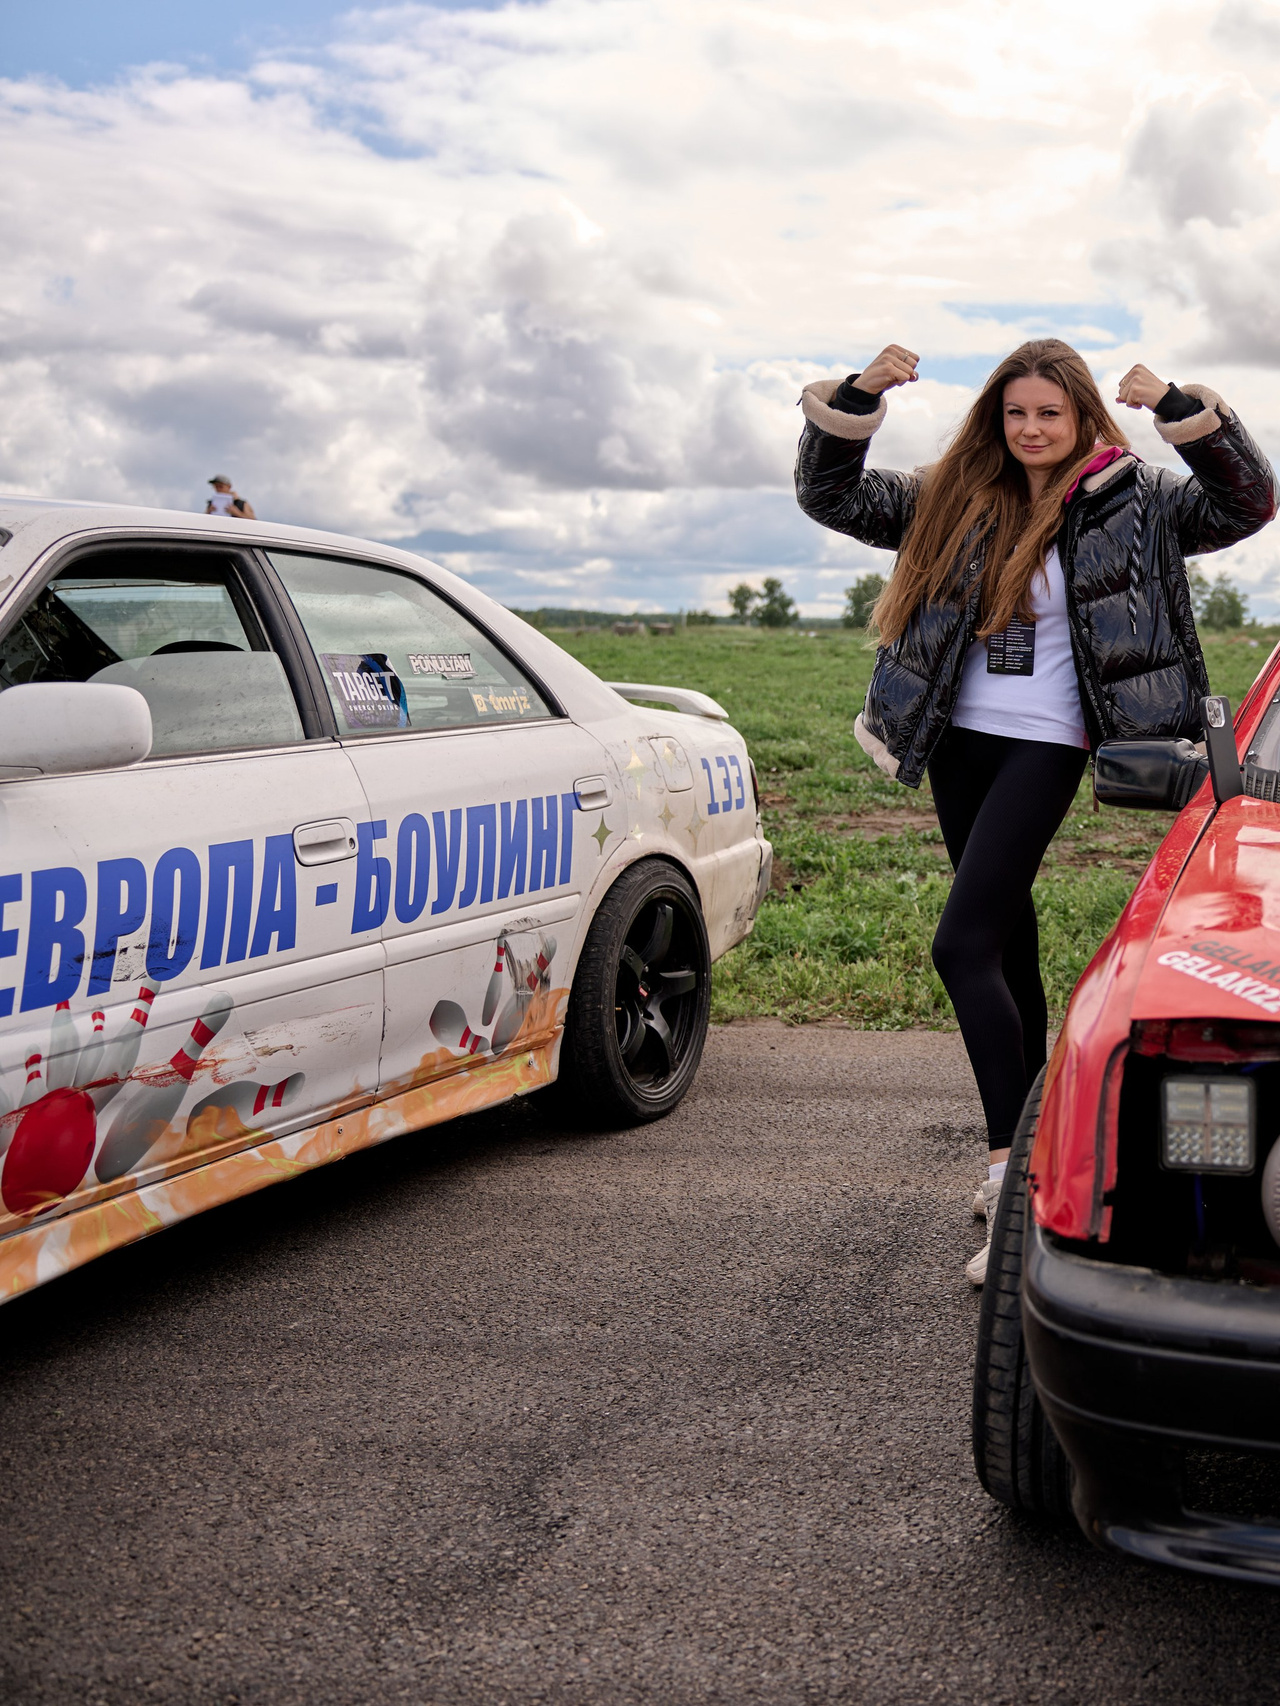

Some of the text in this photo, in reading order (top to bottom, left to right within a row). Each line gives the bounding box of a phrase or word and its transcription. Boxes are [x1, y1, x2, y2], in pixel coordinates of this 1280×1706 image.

[333, 671, 397, 701] TARGET
[701, 755, 746, 815] 133
[352, 791, 581, 935] БОУЛИНГ
